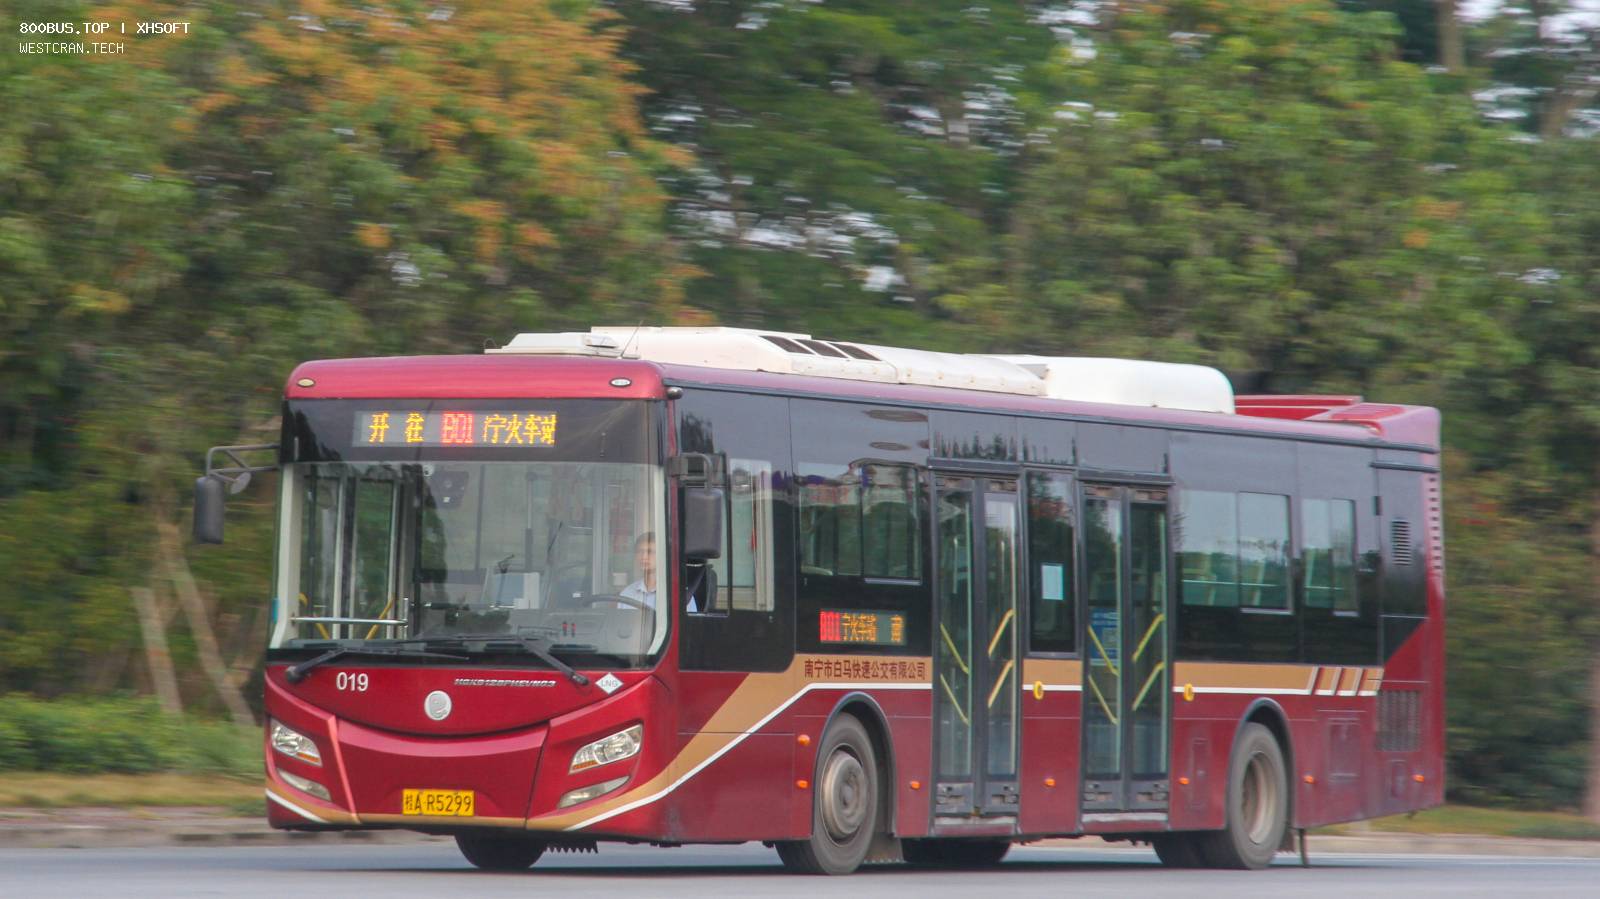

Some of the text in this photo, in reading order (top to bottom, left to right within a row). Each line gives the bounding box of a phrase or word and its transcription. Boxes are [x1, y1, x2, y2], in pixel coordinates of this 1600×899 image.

[803, 658, 927, 681] 南宁市白马快速公交有限公司
[335, 671, 369, 692] 019
[600, 679, 618, 688] LNG
